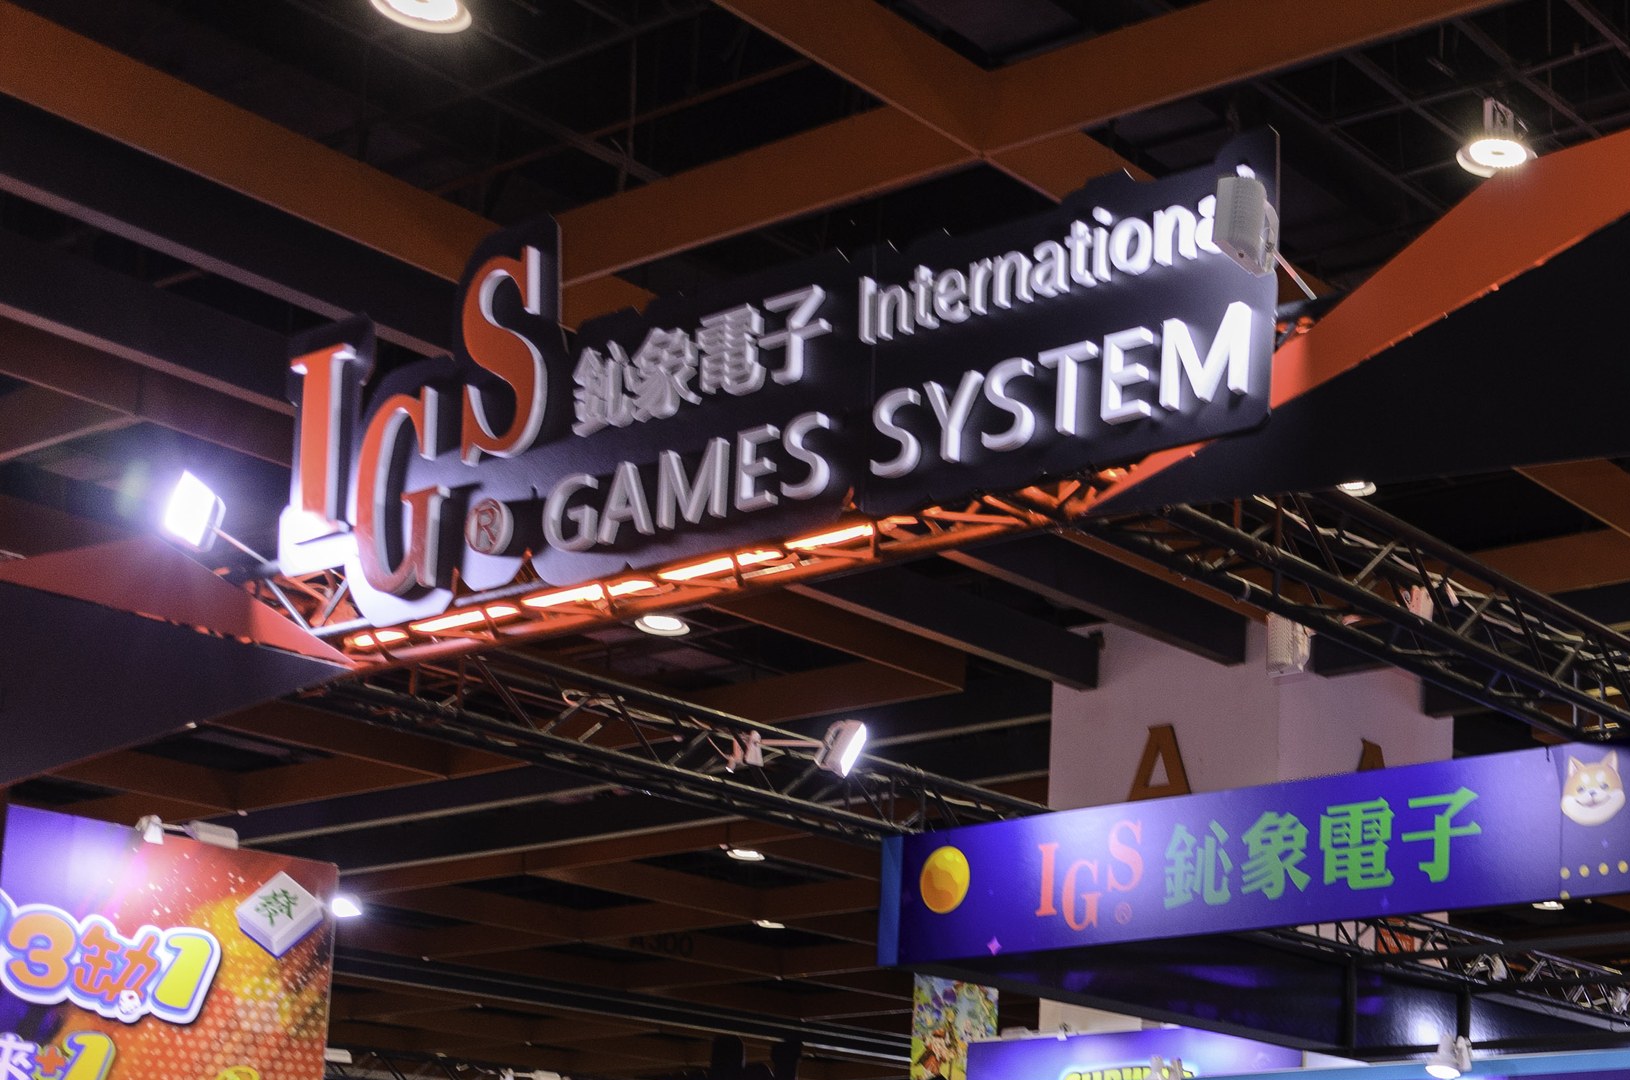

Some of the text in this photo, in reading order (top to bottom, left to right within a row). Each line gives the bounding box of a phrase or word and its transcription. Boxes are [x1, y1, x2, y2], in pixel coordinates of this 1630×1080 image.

[540, 300, 1254, 553] GAMES SYSTEM
[572, 284, 832, 438] 鈊象電子
[1034, 821, 1144, 931] IGS
[1162, 786, 1482, 912] 鈊象電子
